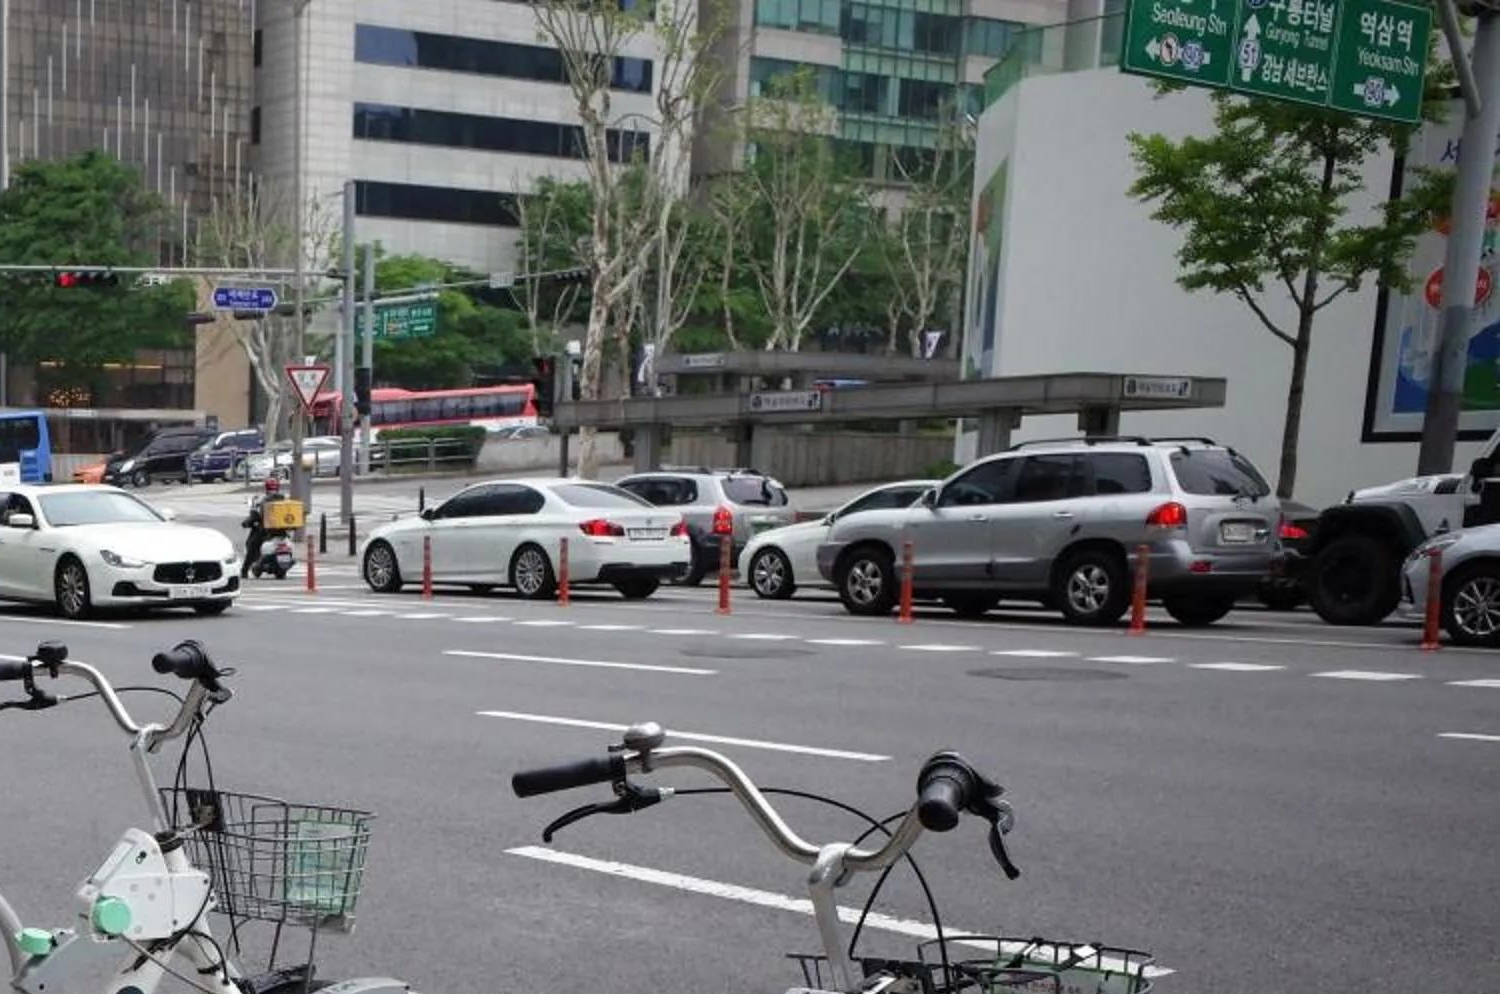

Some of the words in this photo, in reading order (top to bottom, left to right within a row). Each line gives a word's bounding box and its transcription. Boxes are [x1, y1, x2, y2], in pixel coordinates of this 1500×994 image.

[1207, 14, 1228, 36] Stn
[1360, 10, 1414, 51] 역삼역
[1261, 53, 1284, 84] 강남
[1284, 57, 1329, 92] 세브란스
[1357, 48, 1402, 74] Yeoksam
[1402, 55, 1420, 77] Stn
